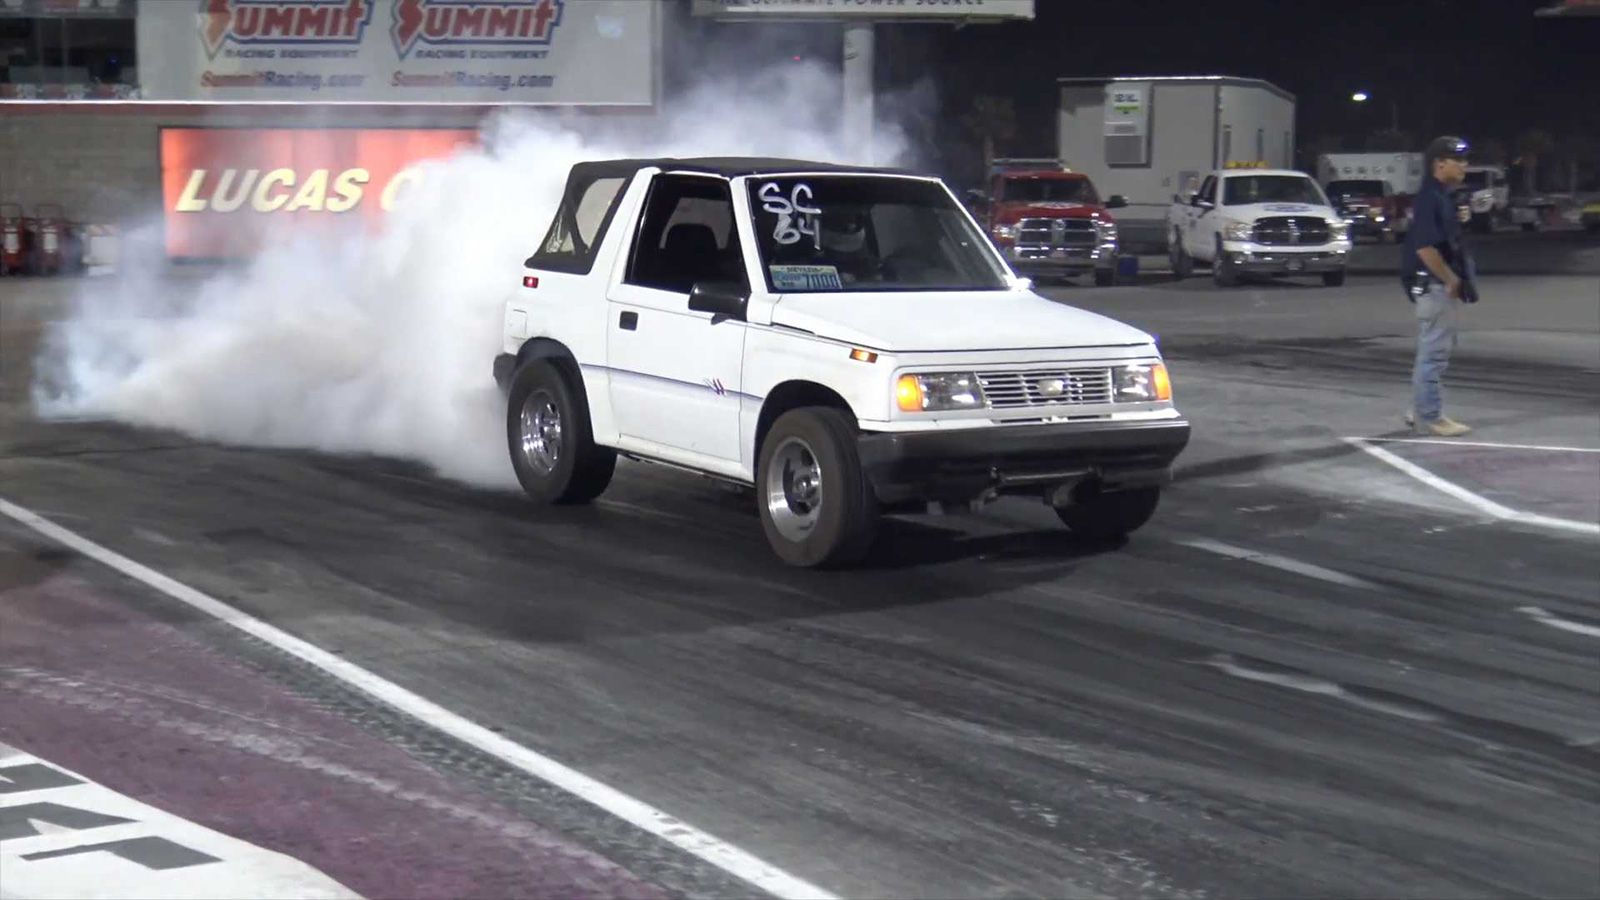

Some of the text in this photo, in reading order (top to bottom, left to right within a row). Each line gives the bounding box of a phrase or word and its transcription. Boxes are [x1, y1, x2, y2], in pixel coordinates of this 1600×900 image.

[225, 50, 275, 58] RACING
[415, 50, 549, 58] RACING EQUIPMENT
[201, 71, 368, 91] SummitRacing.com
[391, 71, 555, 91] SummitRacing.com
[175, 168, 369, 212] LUCAS
[759, 182, 822, 214] SC
